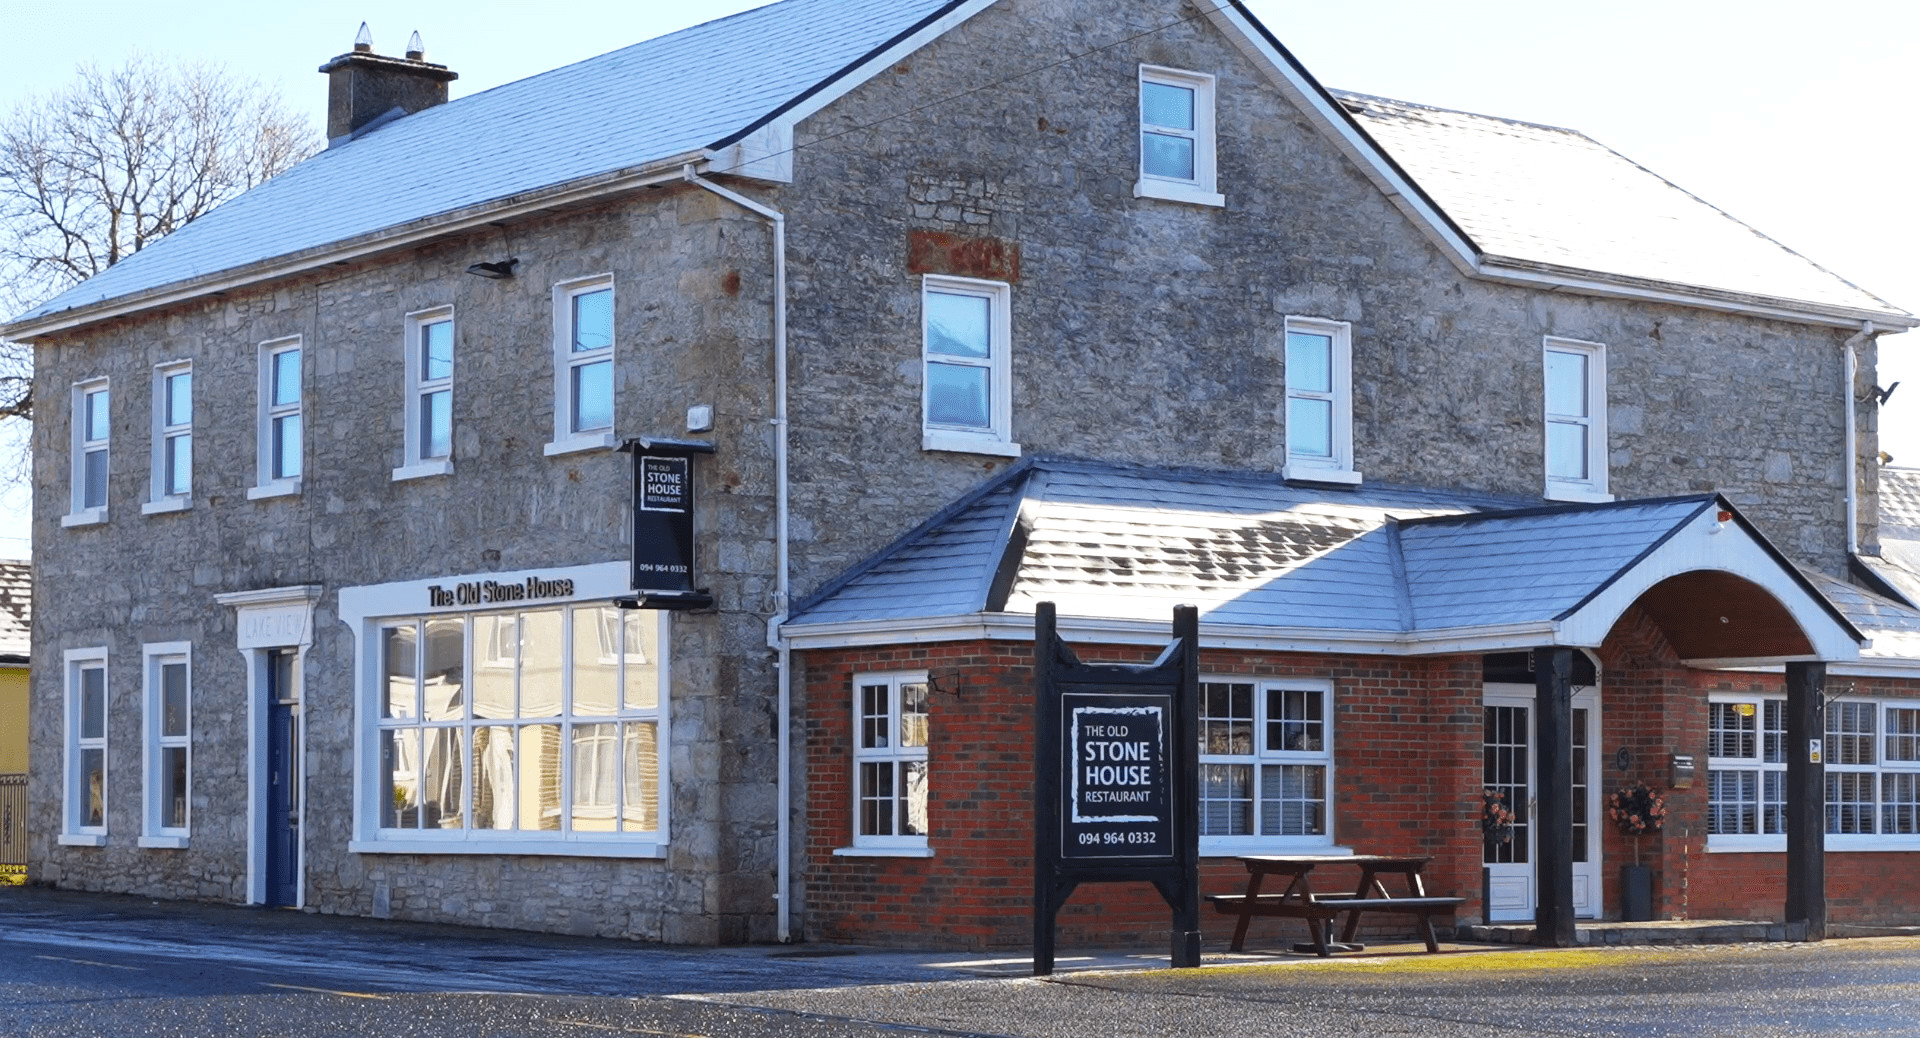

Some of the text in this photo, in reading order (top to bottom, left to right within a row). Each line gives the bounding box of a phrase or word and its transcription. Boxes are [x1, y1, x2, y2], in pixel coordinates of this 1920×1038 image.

[647, 472, 681, 484] STONE
[647, 484, 682, 495] HOUSE
[647, 495, 682, 503] RESTAURANT
[640, 563, 688, 573] 094 964 0332
[428, 576, 575, 607] The Old Stone House
[245, 614, 303, 638] LAKE VIEW
[1084, 725, 1129, 737] THE OLD
[1085, 741, 1151, 762] STONE
[1085, 766, 1151, 786] HOUSE
[1085, 790, 1151, 803] RESTAURANT
[1079, 832, 1157, 845] 094 964 0332
